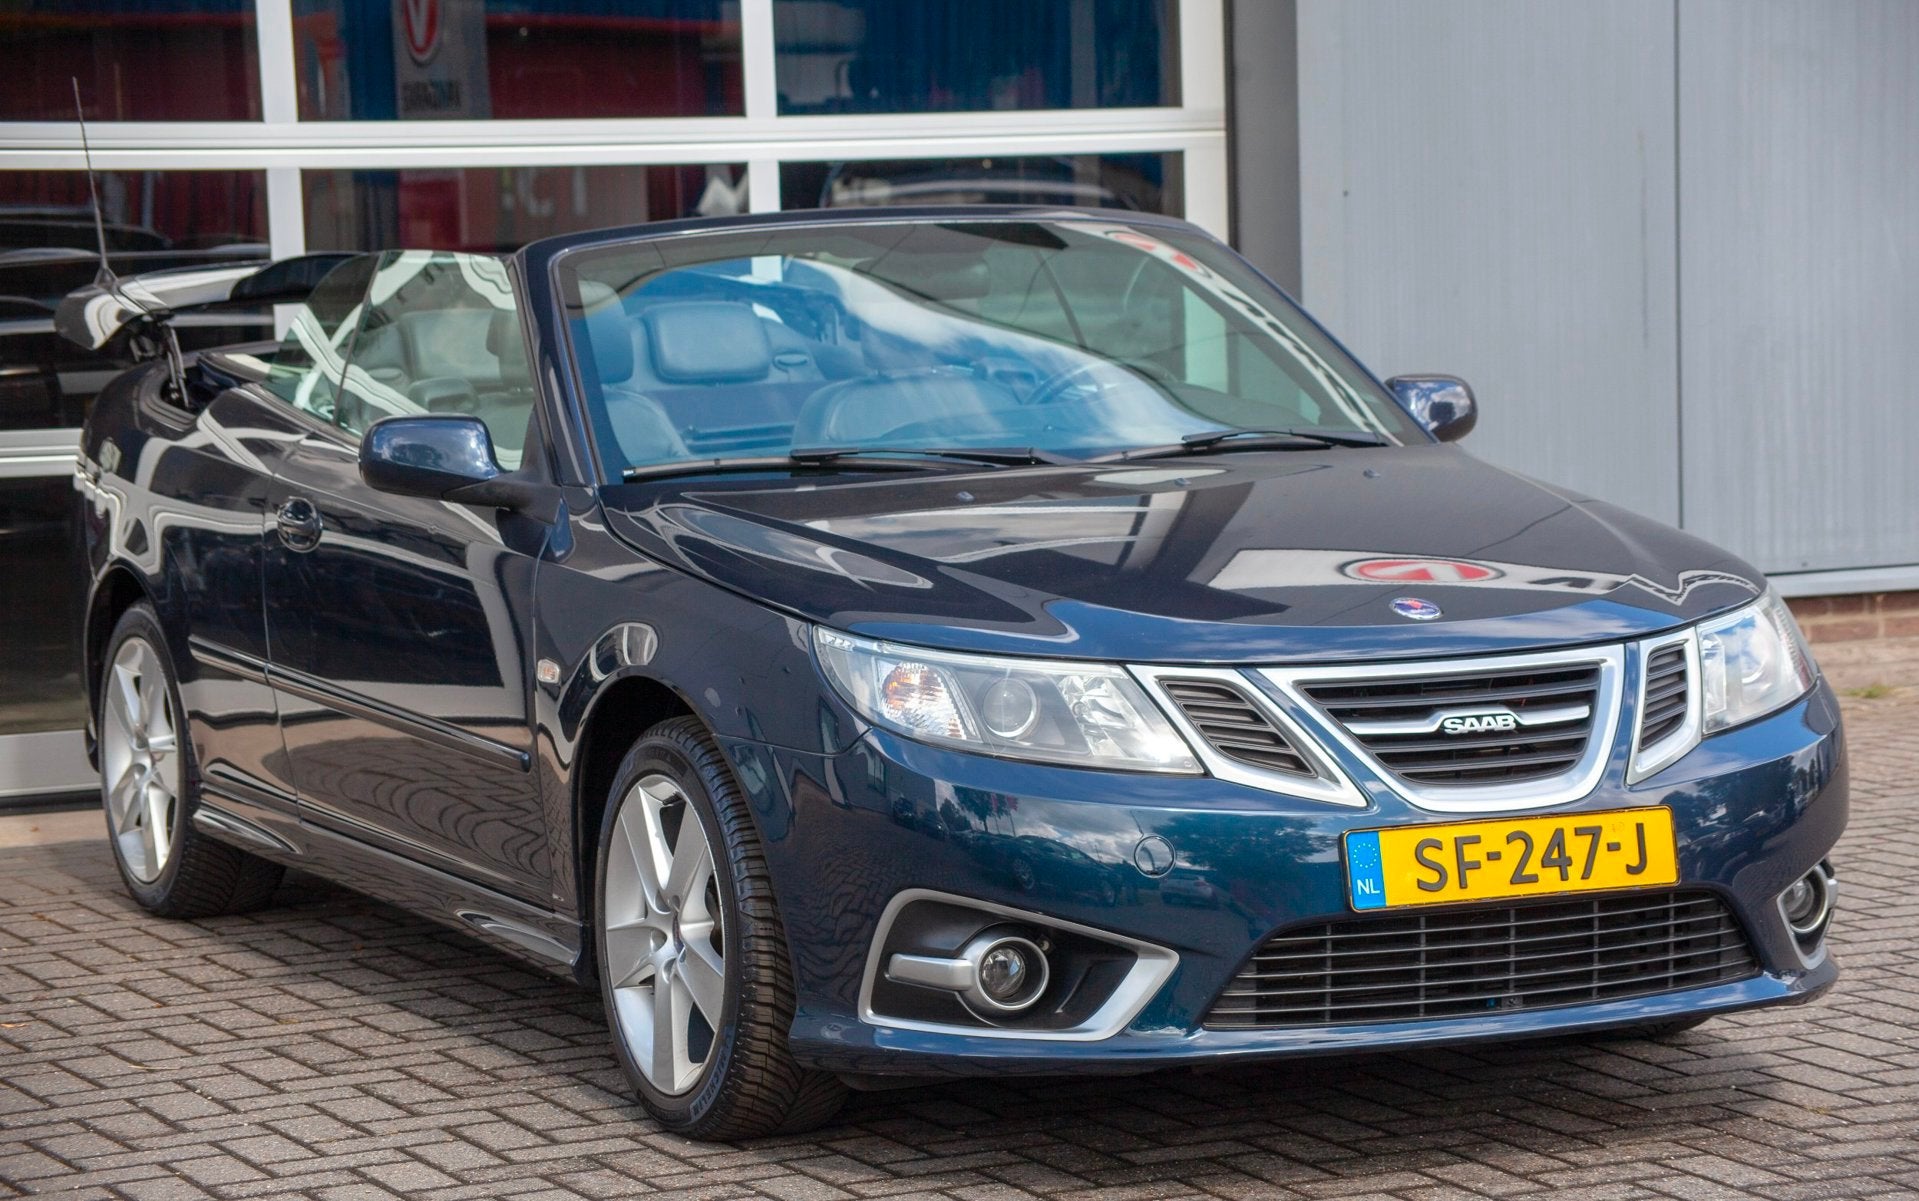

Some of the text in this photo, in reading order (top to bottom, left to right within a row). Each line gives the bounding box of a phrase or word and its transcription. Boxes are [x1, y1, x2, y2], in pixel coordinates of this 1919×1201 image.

[1443, 714, 1517, 735] SAAB
[1414, 822, 1649, 893] SF-247-J
[1357, 878, 1381, 896] NL
